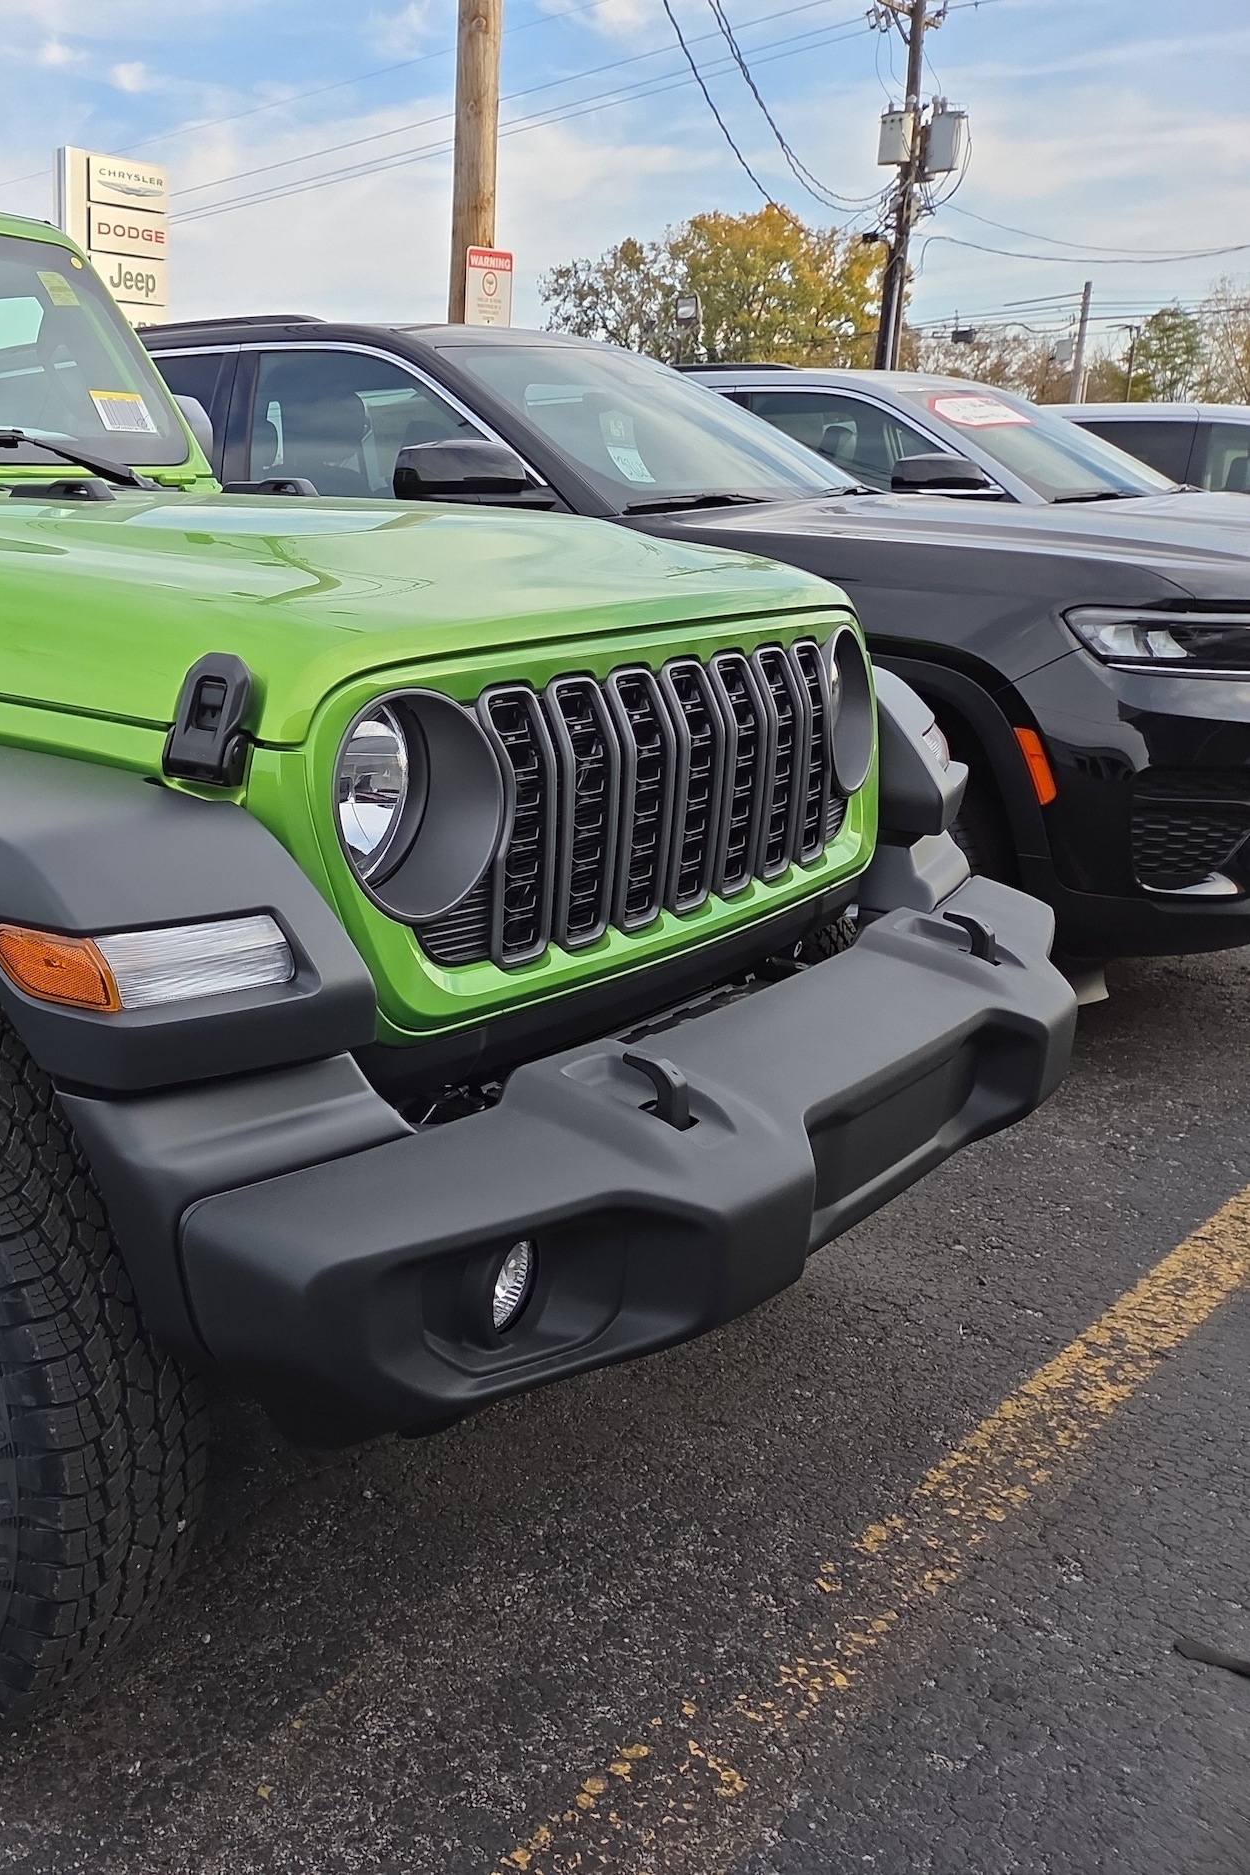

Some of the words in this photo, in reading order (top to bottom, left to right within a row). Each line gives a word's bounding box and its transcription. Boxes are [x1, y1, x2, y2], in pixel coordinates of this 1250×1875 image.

[98, 168, 164, 187] CHRYSLER
[97, 222, 165, 244] DODGE
[470, 254, 511, 270] WARNING
[109, 262, 157, 298] Jeep
